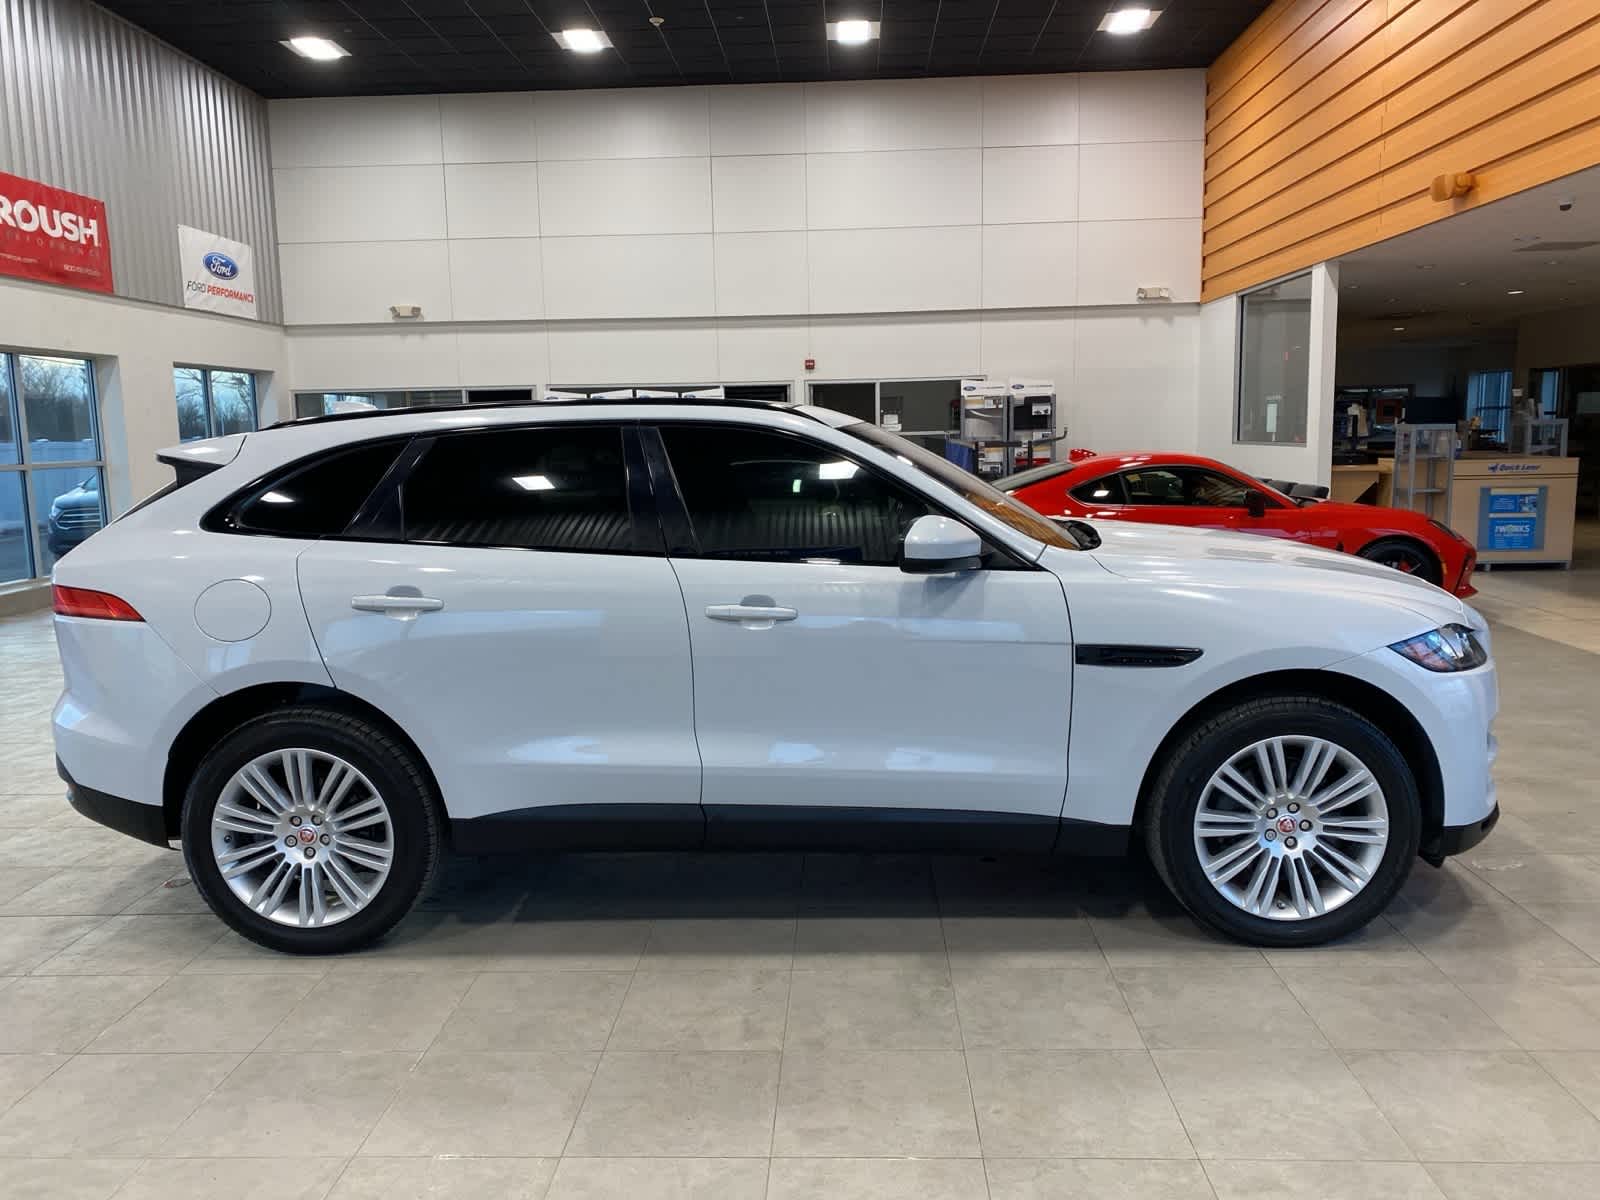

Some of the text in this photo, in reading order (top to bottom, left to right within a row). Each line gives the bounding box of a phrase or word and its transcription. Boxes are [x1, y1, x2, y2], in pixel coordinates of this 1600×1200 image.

[0, 194, 99, 247] ROUSH
[210, 256, 233, 276] Ford
[186, 281, 207, 293] FORD
